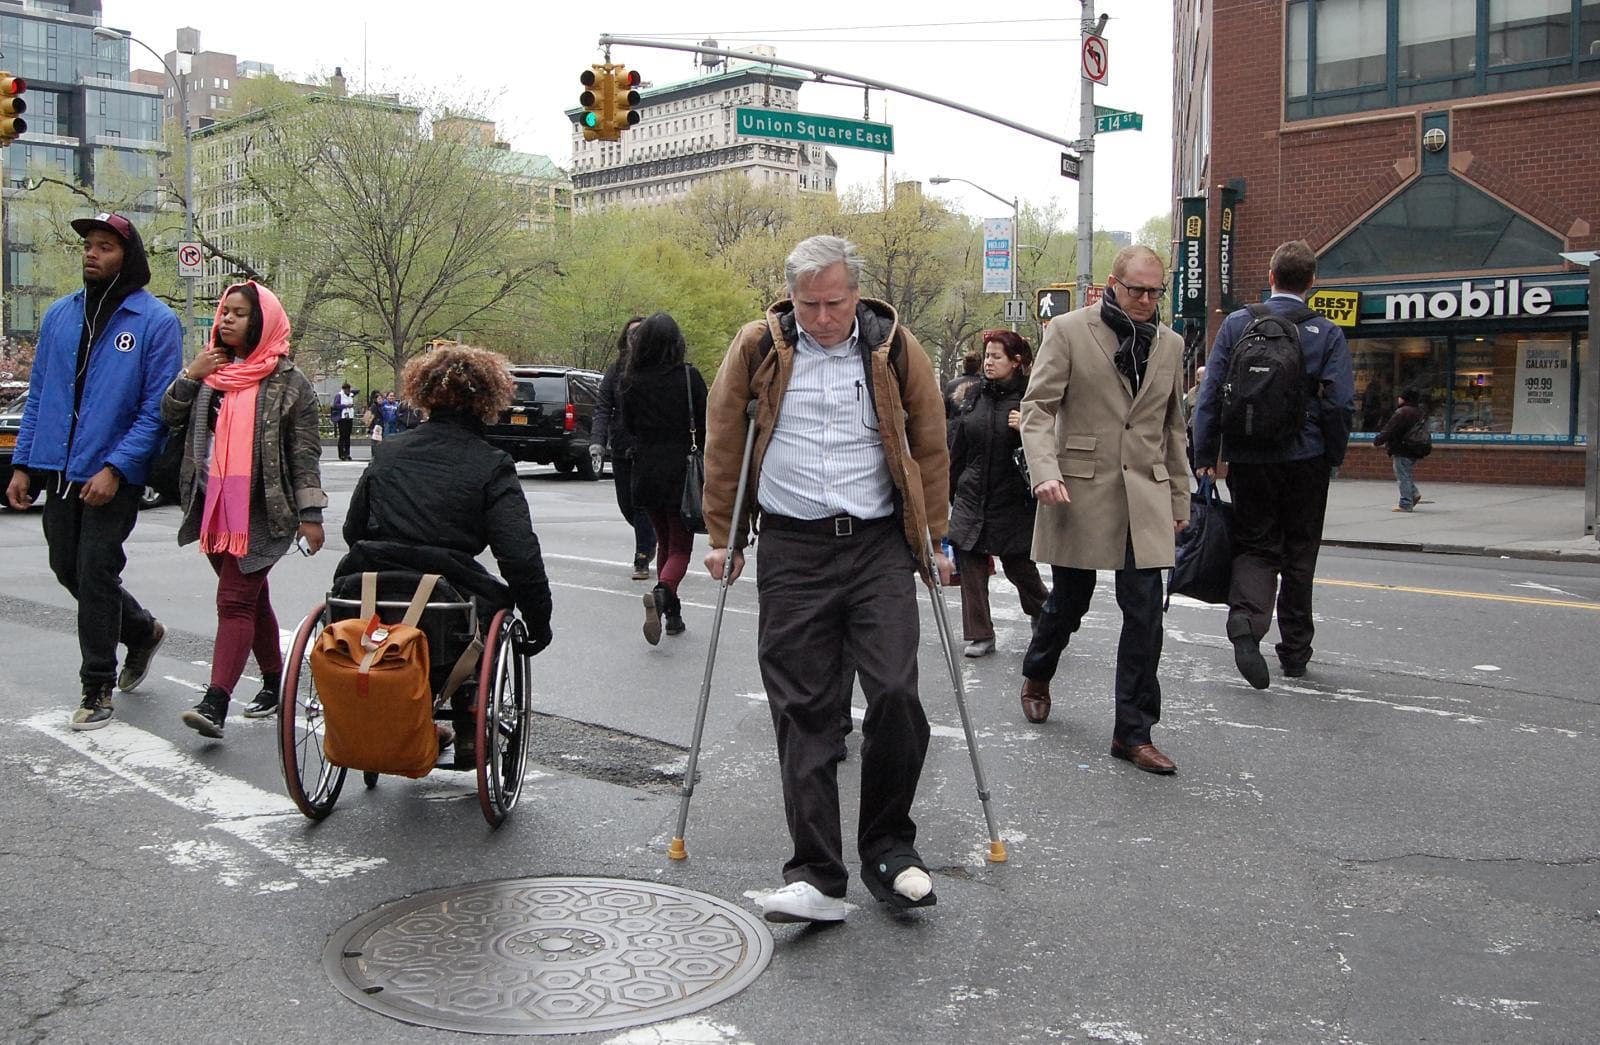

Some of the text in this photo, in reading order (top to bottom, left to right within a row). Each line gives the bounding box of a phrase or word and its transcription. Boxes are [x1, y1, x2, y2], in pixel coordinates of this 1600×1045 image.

[742, 115, 888, 145] Union Square East
[1097, 114, 1133, 132] E 14 ST
[1188, 241, 1202, 299] mobile
[1221, 234, 1230, 295] mobile
[1314, 297, 1357, 309] BEST
[1385, 279, 1552, 320] mobile
[118, 332, 132, 351] 8
[1526, 360, 1553, 369] GALAXY
[1524, 377, 1553, 390] $99.99
